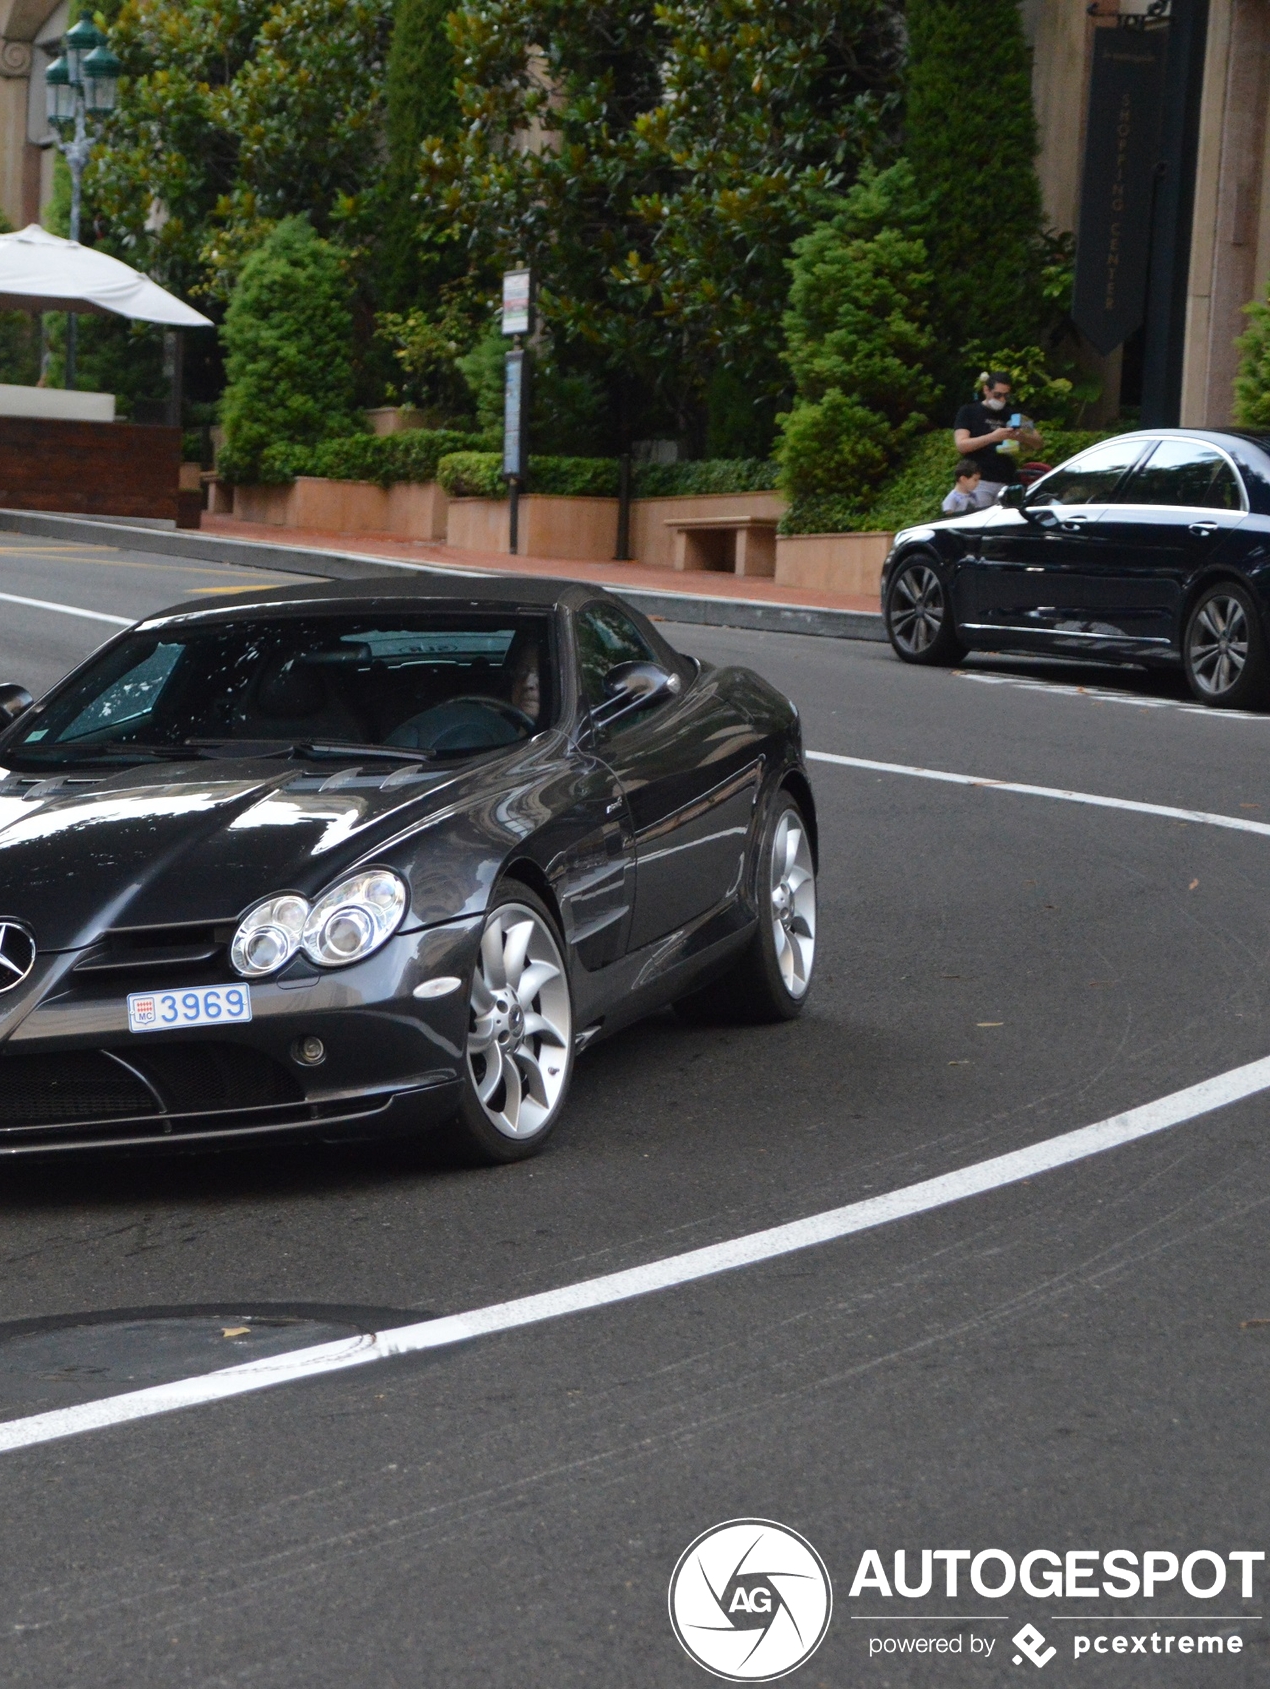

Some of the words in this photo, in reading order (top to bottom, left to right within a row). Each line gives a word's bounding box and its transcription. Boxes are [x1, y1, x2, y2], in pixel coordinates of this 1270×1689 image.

[1111, 93, 1131, 212] SHOPPING
[1105, 222, 1121, 310] CENTER
[138, 1011, 153, 1020] MC
[161, 989, 244, 1022] 3969
